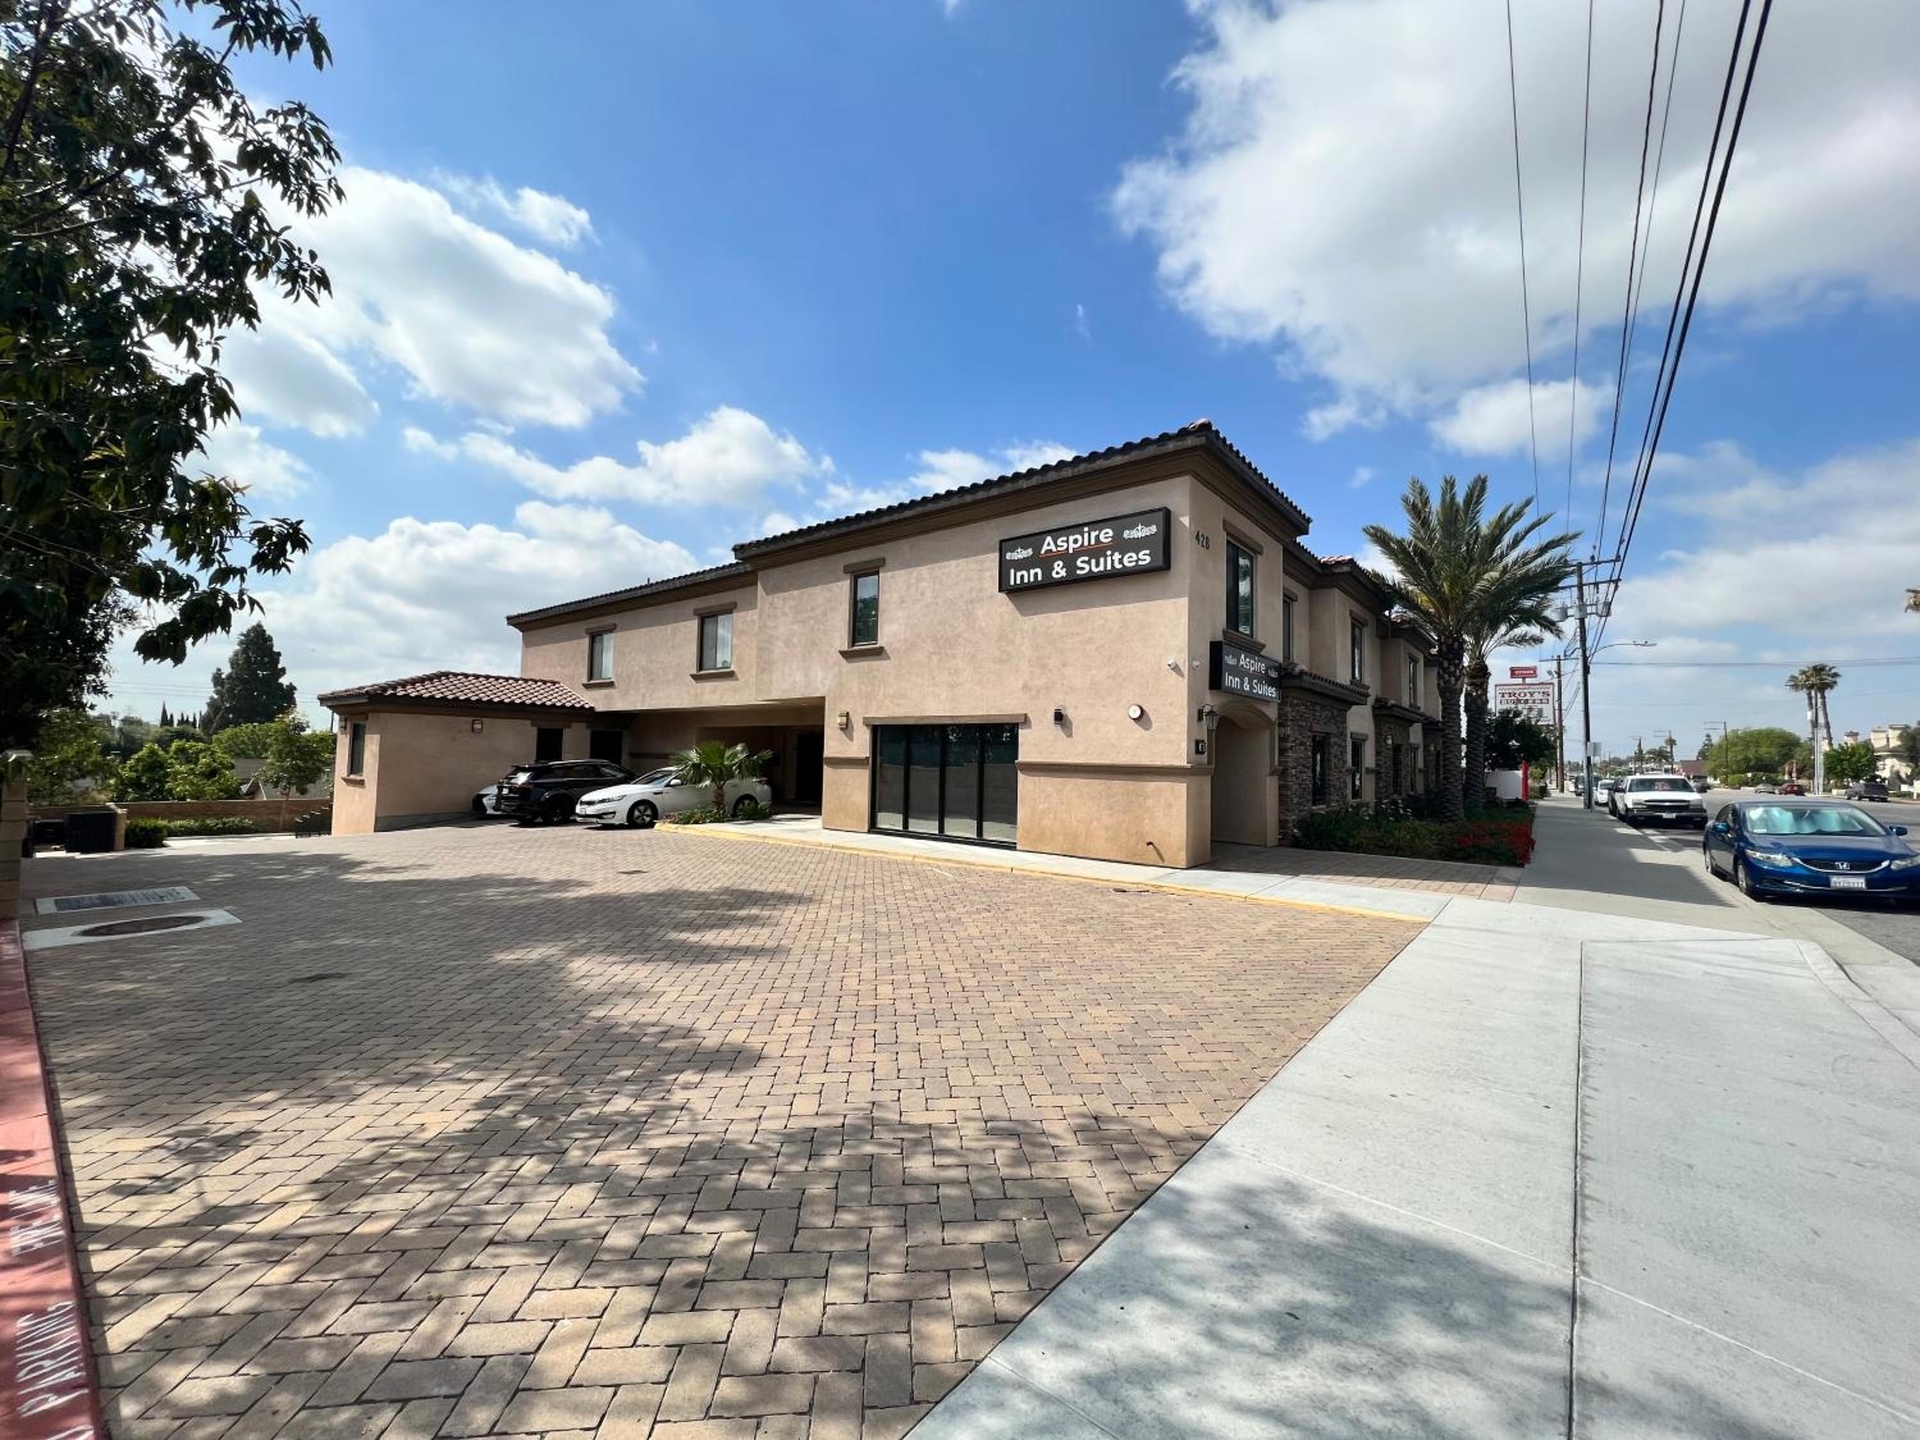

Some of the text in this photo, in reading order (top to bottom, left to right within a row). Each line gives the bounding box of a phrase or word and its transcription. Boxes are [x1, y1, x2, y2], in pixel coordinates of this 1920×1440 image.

[1040, 527, 1114, 555] Aspire
[1009, 549, 1152, 586] Inn & Suites
[1239, 653, 1266, 674] Aspire
[1225, 671, 1277, 698] Inn & Suites
[1498, 690, 1550, 699] TROY'S
[15, 1300, 89, 1418] PARKING
